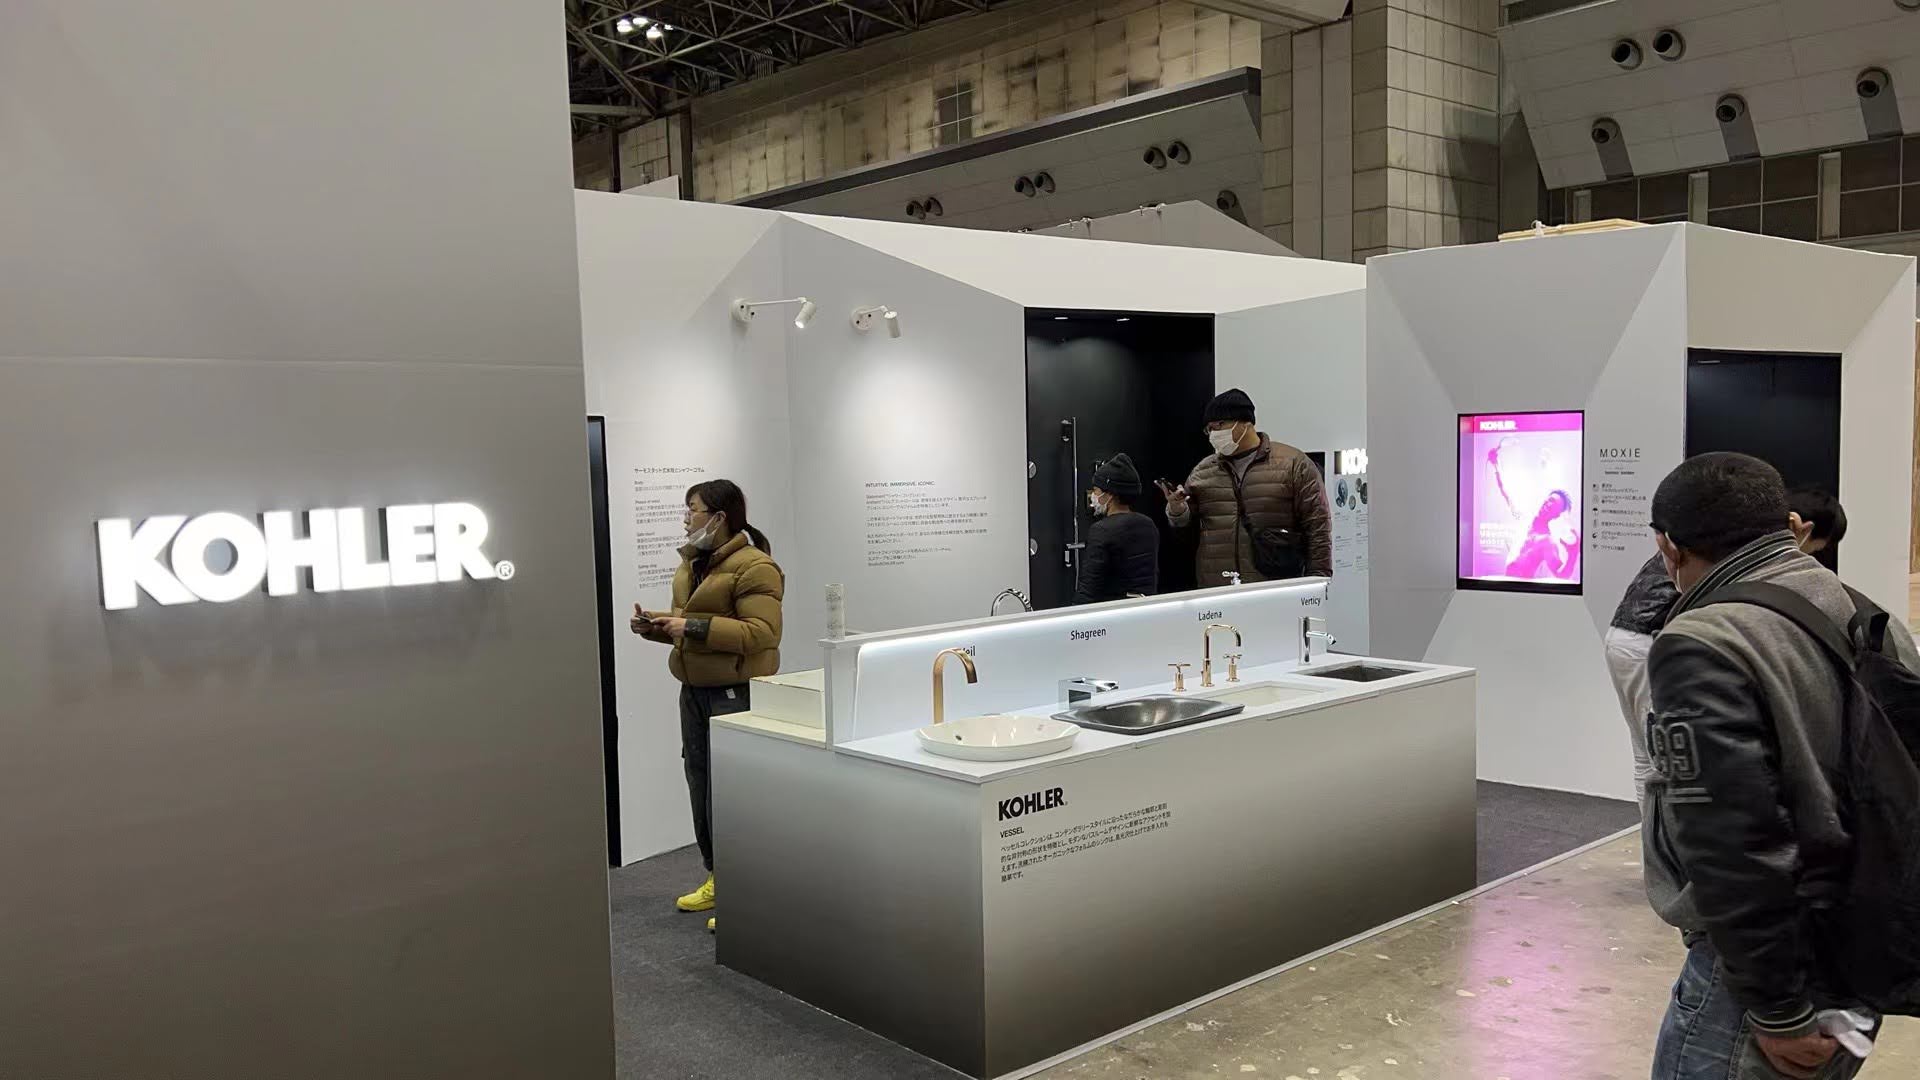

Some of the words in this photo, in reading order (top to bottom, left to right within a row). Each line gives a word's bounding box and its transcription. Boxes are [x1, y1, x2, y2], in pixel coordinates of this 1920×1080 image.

[1600, 448, 1641, 458] MOXIE
[1300, 597, 1321, 606] Verticy
[1198, 611, 1222, 621] Ladena
[1070, 627, 1107, 641] Shagreen
[962, 645, 976, 657] eil
[1000, 826, 1025, 839] VESSEL
